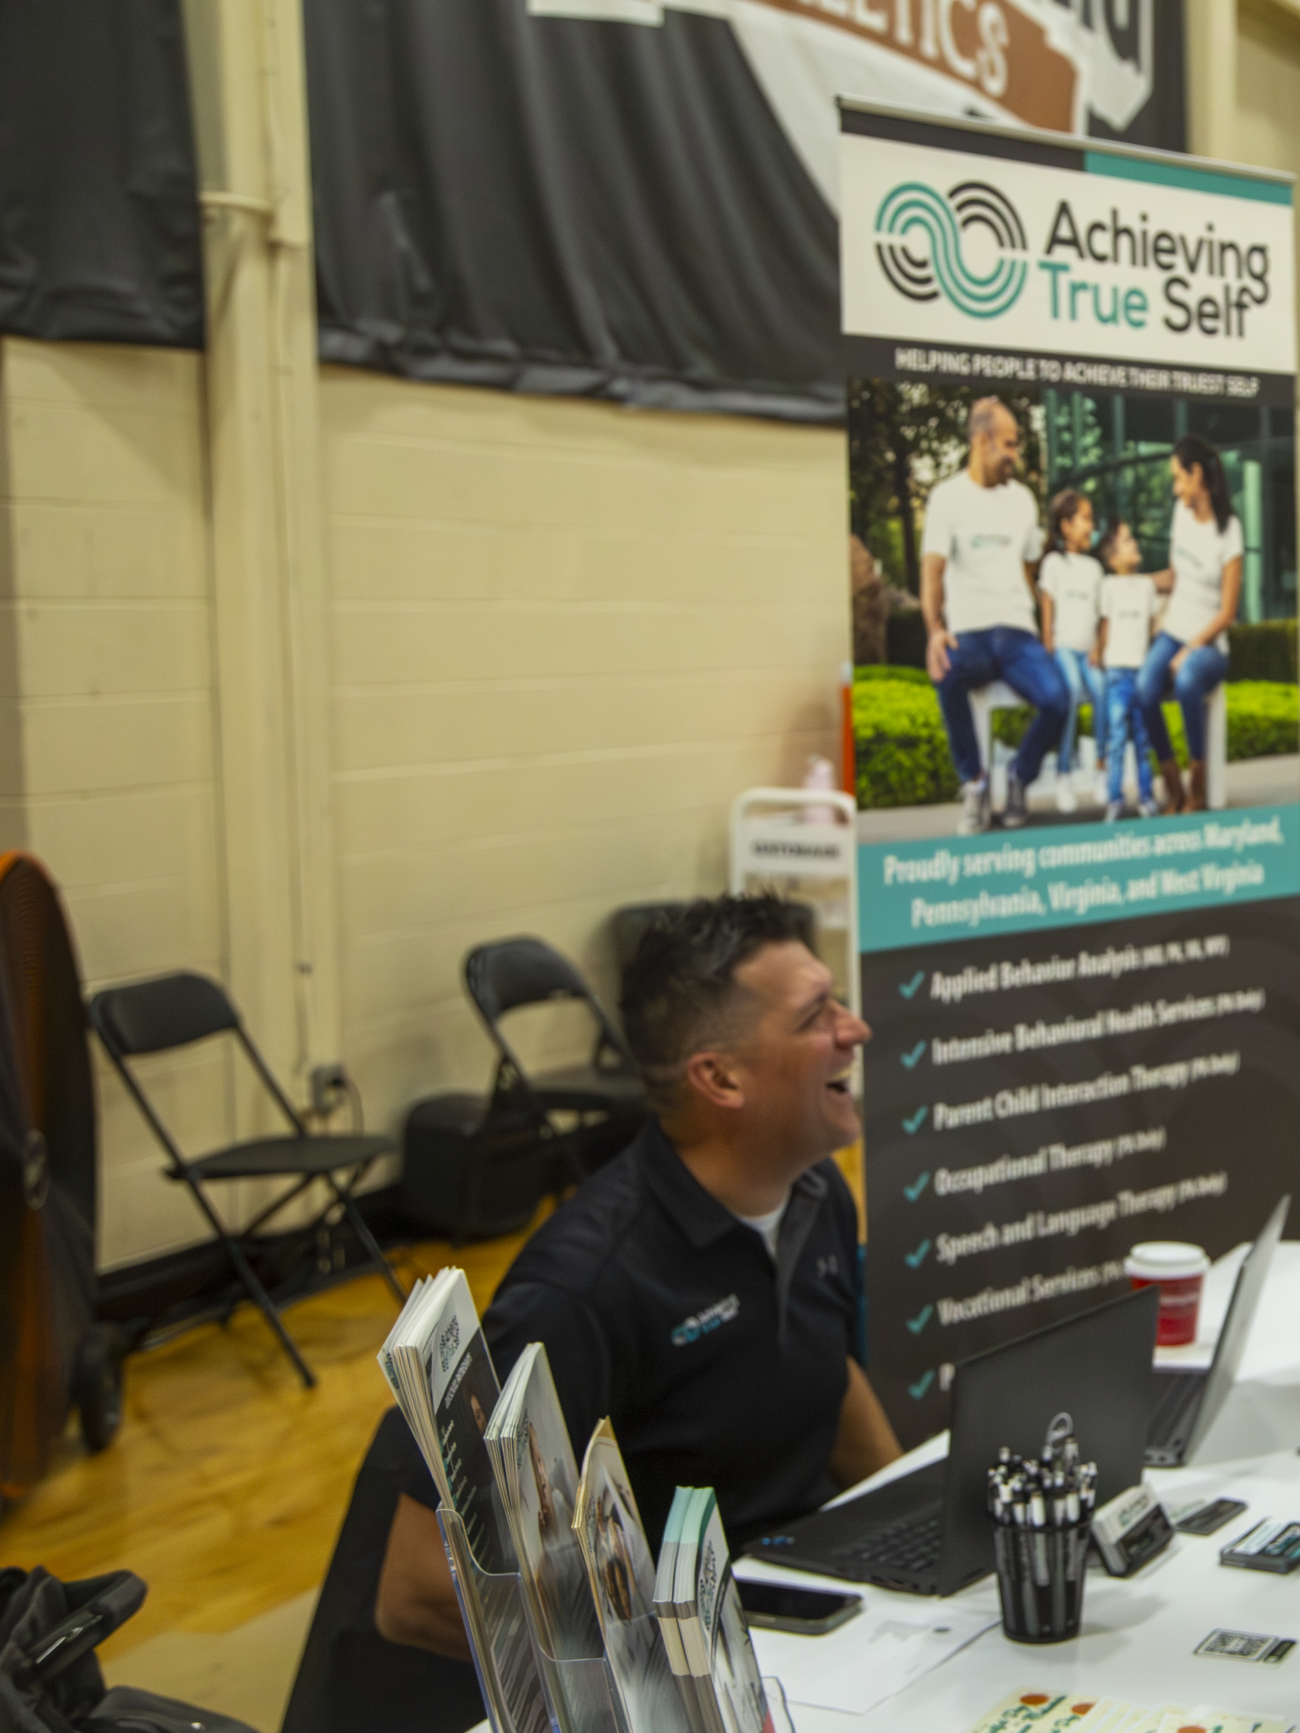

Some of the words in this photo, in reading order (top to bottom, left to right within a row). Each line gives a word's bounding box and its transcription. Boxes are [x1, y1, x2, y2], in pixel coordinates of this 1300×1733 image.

[1045, 197, 1270, 305] Achieving
[1037, 259, 1149, 329] True
[1163, 273, 1250, 338] Self
[895, 346, 971, 376] HELPING
[971, 352, 1037, 381] PEOPLE
[1039, 358, 1062, 382] TO
[1062, 361, 1127, 388] ACHIEVE
[1128, 365, 1171, 391] THEIR
[1172, 370, 1225, 396] TRUEST
[1226, 374, 1260, 398] SELF
[884, 848, 961, 886] Proudly
[963, 842, 1036, 879] serving
[1038, 831, 1150, 869] communities
[1153, 829, 1202, 856] across
[1203, 815, 1284, 853] Maryland,
[911, 885, 1047, 929] Pennsylvania,
[1047, 875, 1124, 916] Virginia,
[1126, 869, 1158, 903] and
[1161, 868, 1200, 896] West
[1201, 859, 1265, 896] Virginia
[930, 962, 999, 1005] Applied
[1000, 954, 1076, 989] Behavior
[1077, 942, 1141, 980] Analysis
[932, 1028, 1013, 1066] Intensive
[1014, 1009, 1105, 1053] Behavioral
[1105, 1001, 1154, 1036] Health
[1156, 993, 1215, 1028] Services
[933, 1096, 994, 1131] Parent
[994, 1083, 1040, 1119] Child
[1041, 1071, 1130, 1110] Interaction
[1130, 1063, 1189, 1091] Therapy
[934, 1146, 1048, 1196] Occupational
[1049, 1138, 1113, 1170] Therapy
[936, 1221, 1000, 1267] Speech
[1001, 1212, 1035, 1246] and
[1036, 1199, 1117, 1237] Language
[1117, 1183, 1176, 1218] Therapy
[936, 1275, 1031, 1328] Vocational
[1031, 1264, 1101, 1303] Services
